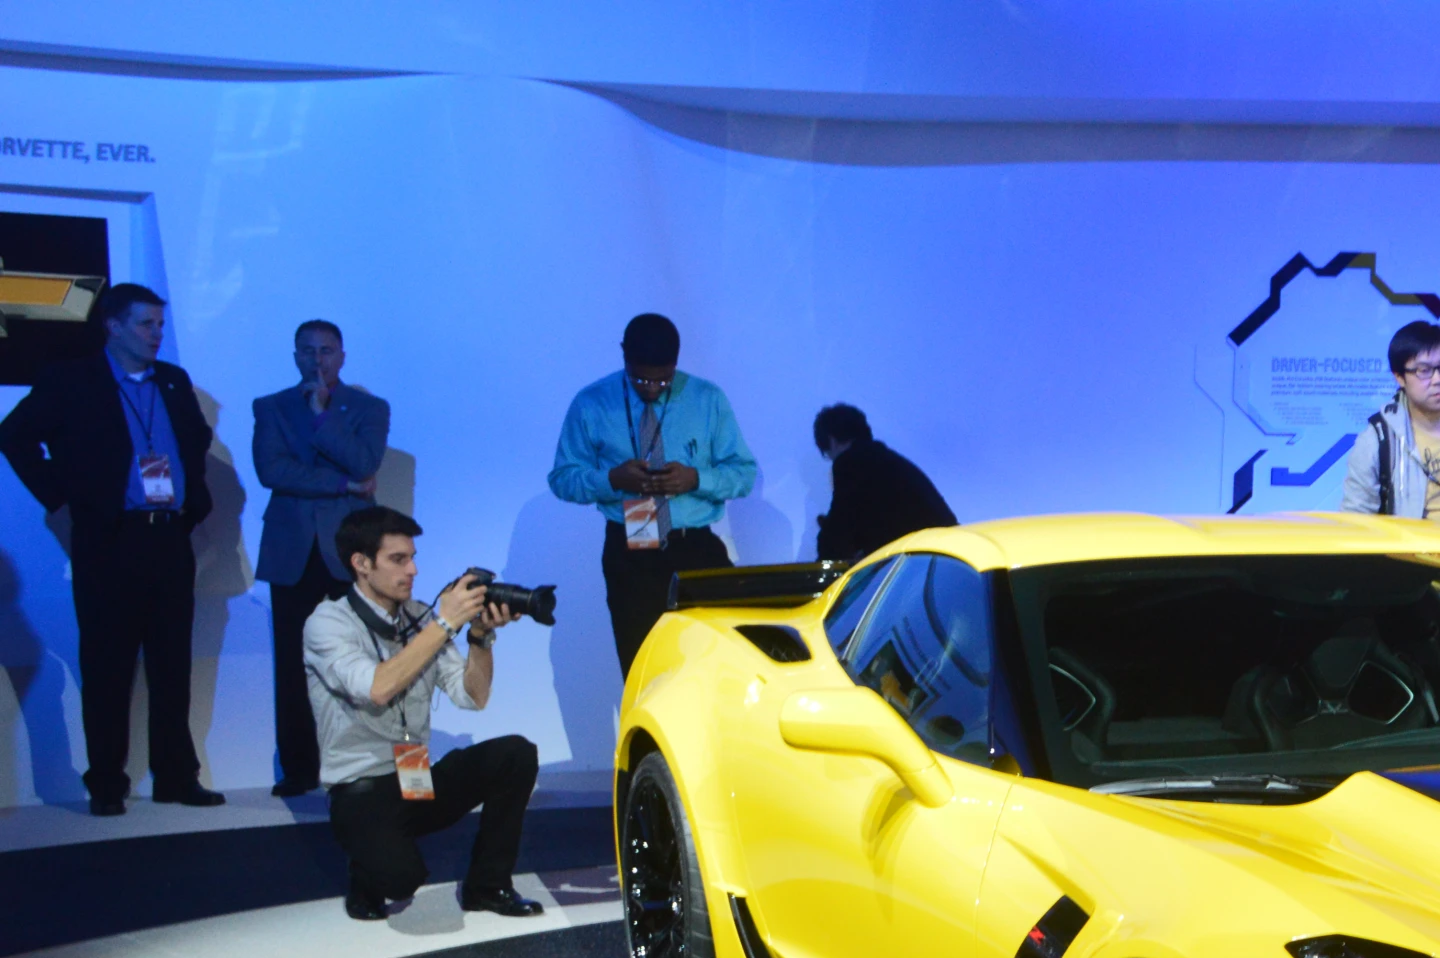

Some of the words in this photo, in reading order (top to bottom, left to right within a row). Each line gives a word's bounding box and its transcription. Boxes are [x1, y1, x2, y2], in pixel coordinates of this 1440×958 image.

[0, 137, 90, 163] RVETTE,
[96, 142, 156, 163] EVER.
[1271, 357, 1383, 373] DRIVER-FOCUSED
